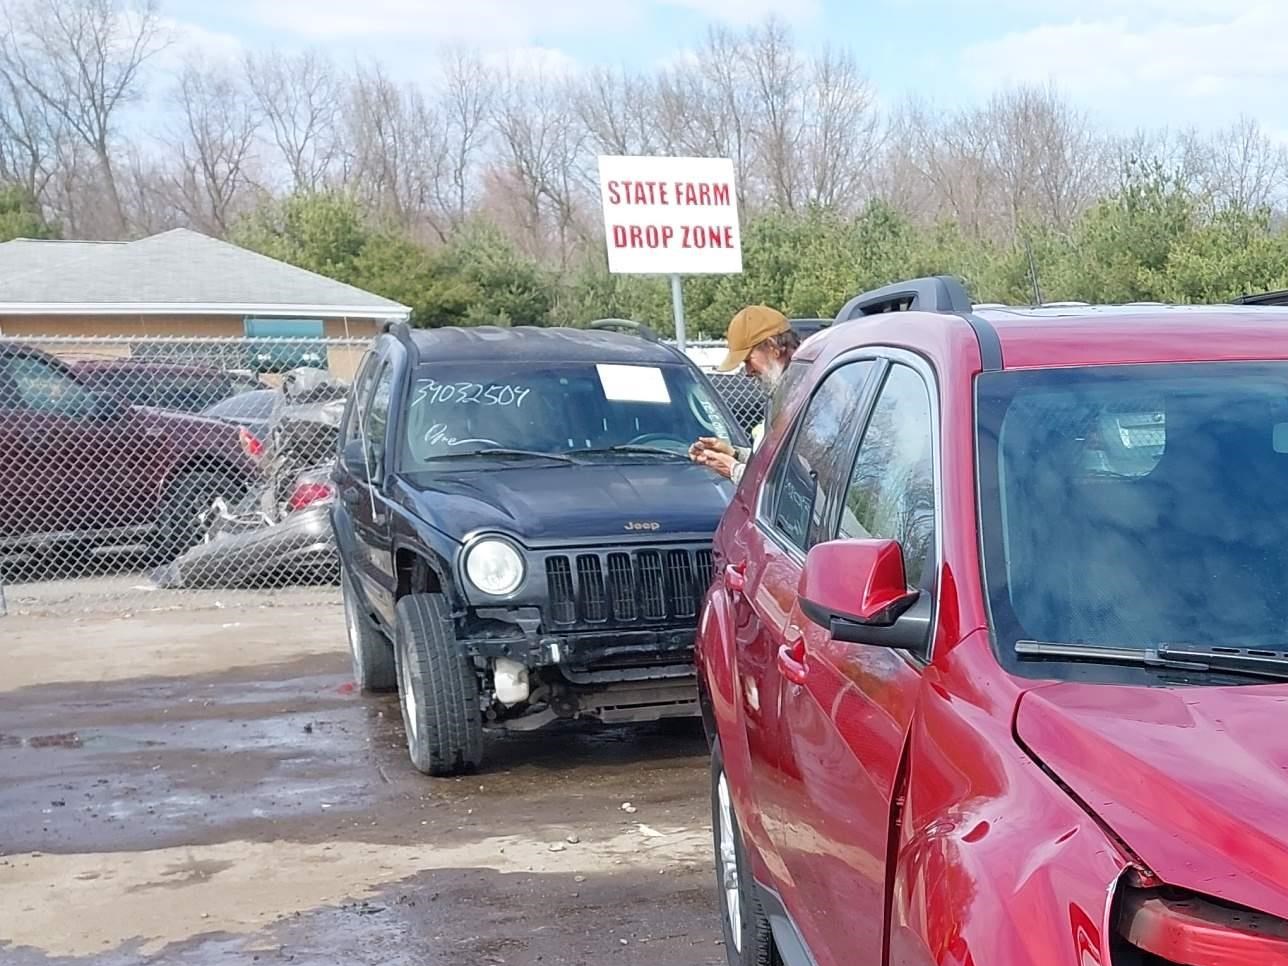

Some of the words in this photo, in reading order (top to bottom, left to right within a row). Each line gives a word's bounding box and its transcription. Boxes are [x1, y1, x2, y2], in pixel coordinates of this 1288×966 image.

[607, 180, 670, 205] STATE
[675, 182, 731, 206] FARM
[612, 224, 674, 249] DROP
[681, 226, 735, 249] ZONE
[623, 521, 661, 531] Jeep
